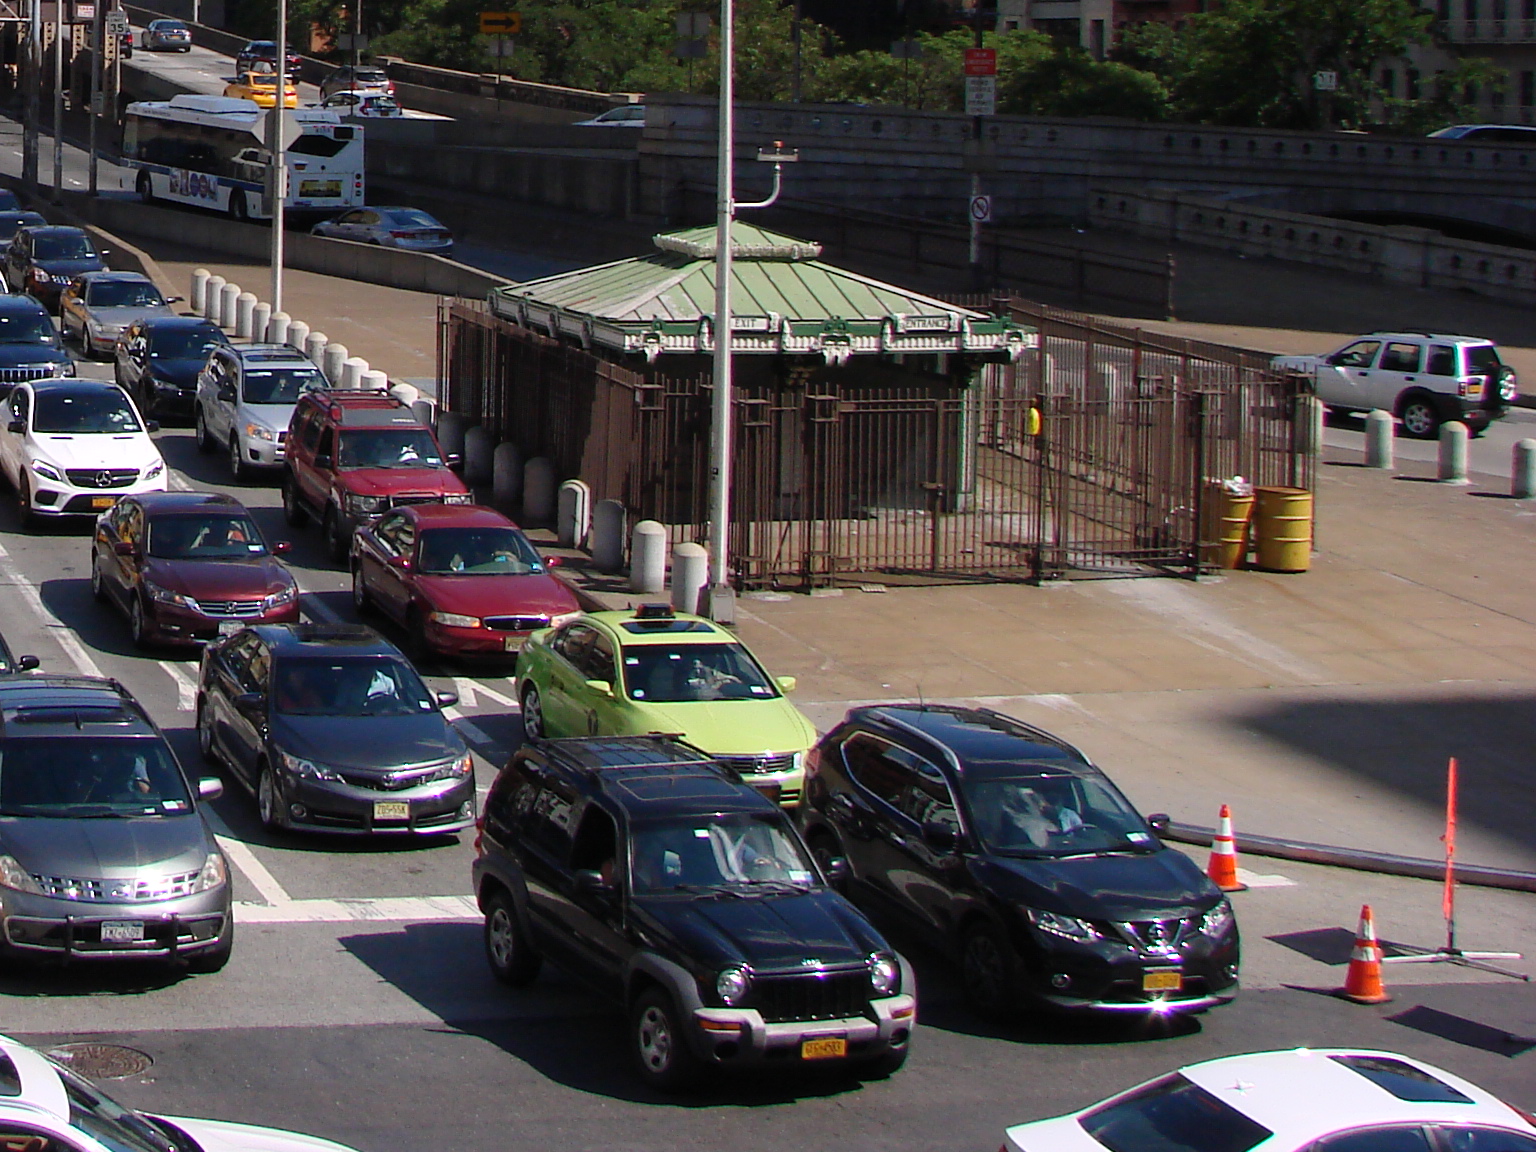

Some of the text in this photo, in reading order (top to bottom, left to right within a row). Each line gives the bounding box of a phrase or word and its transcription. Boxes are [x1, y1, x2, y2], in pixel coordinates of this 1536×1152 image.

[111, 24, 124, 32] 35
[735, 319, 756, 327] EXIT
[907, 319, 947, 330] ENTRANCE
